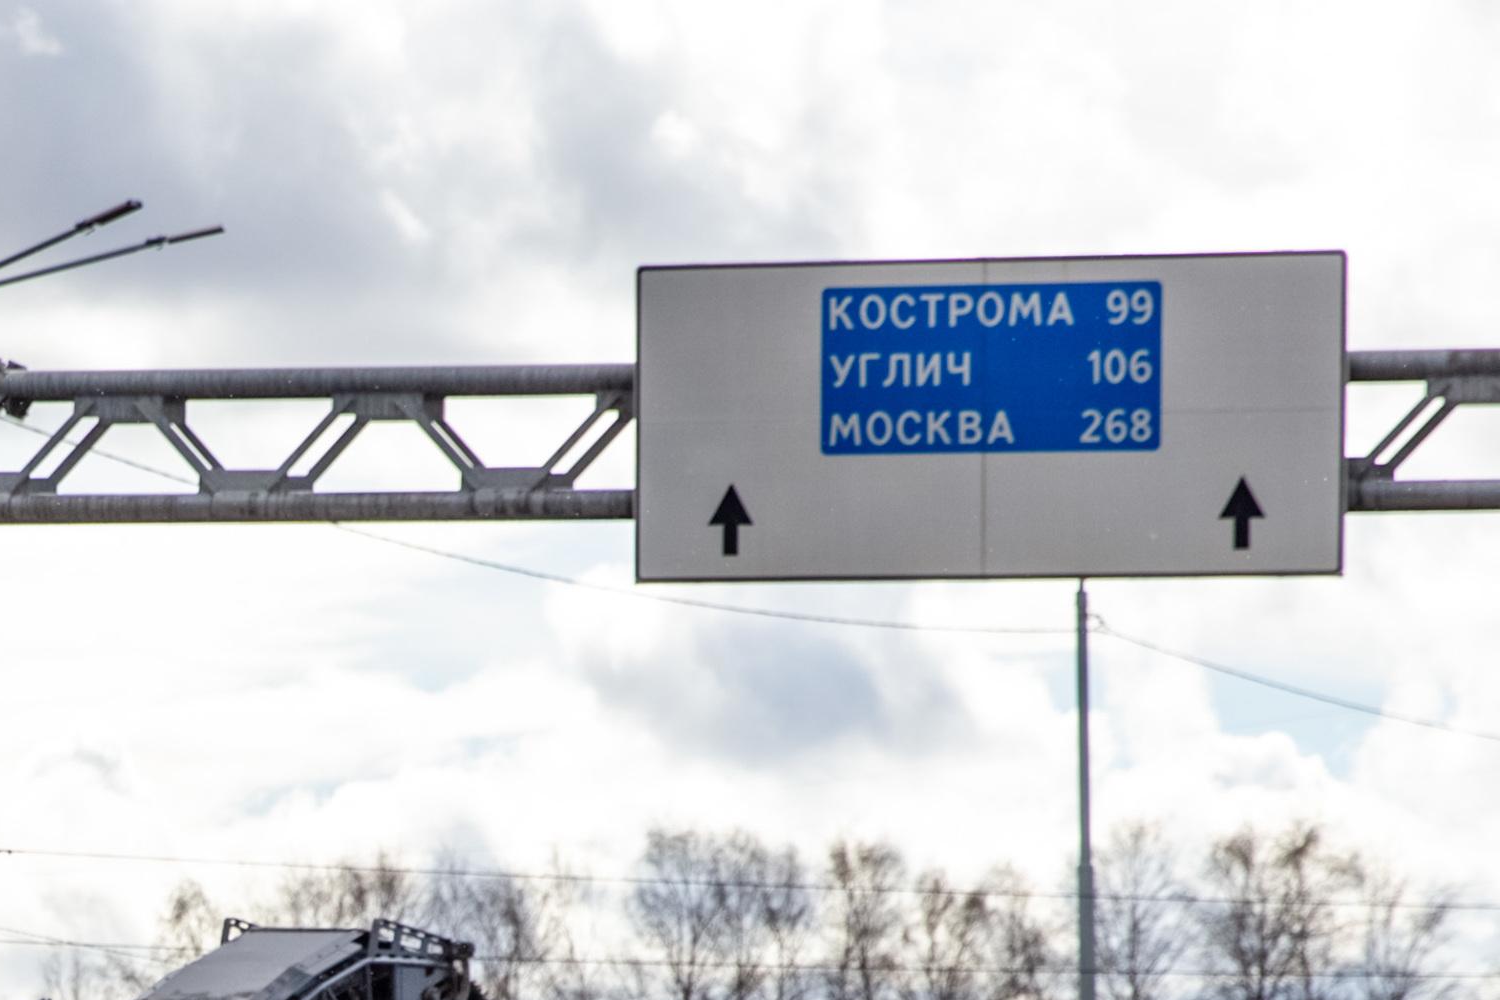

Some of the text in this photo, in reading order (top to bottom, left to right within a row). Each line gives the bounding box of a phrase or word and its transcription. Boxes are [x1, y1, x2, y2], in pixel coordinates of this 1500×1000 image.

[828, 289, 1155, 330] КОСТРОМА 99
[829, 348, 1153, 388] УГЛИЧ 106
[828, 408, 1153, 447] МОСКВА 268
